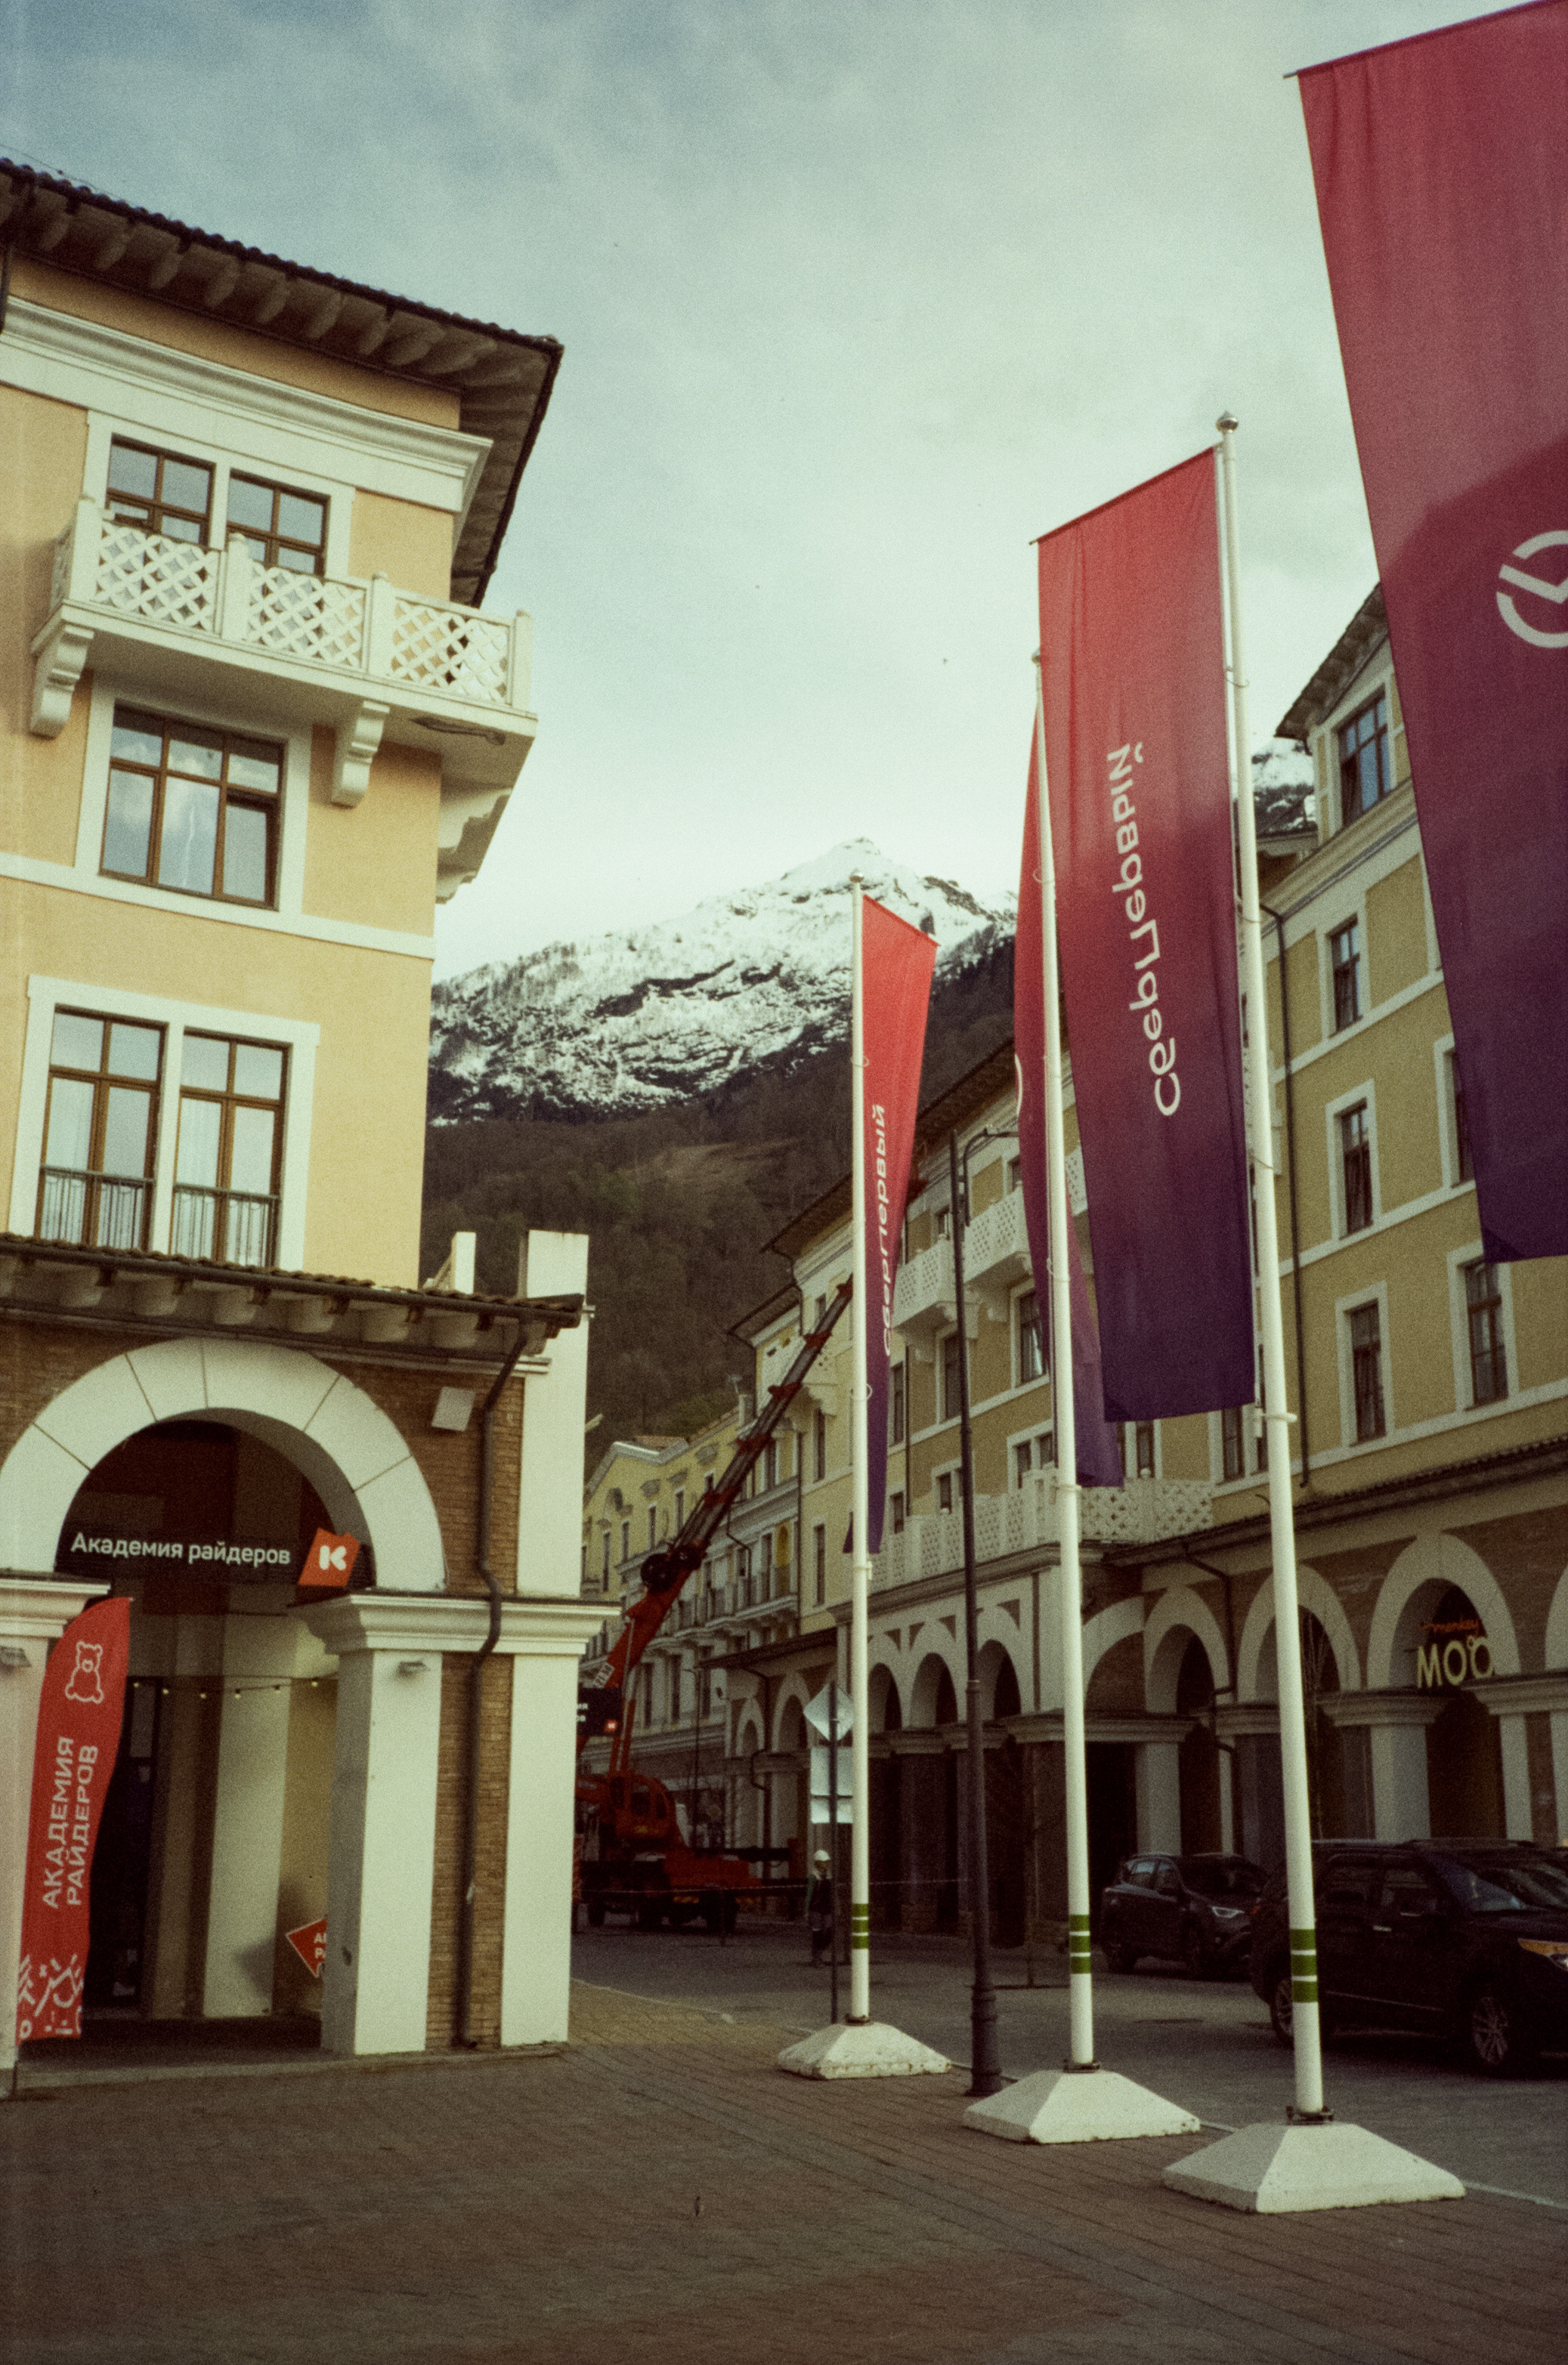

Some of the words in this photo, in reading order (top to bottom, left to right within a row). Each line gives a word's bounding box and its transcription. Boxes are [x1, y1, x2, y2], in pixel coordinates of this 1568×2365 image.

[70, 1532, 184, 1559] Академия
[187, 1541, 291, 1569] райдеров
[42, 1736, 74, 1909] АКАДЕМИЯ
[66, 1745, 99, 1906] РАЙДЕРОВ
